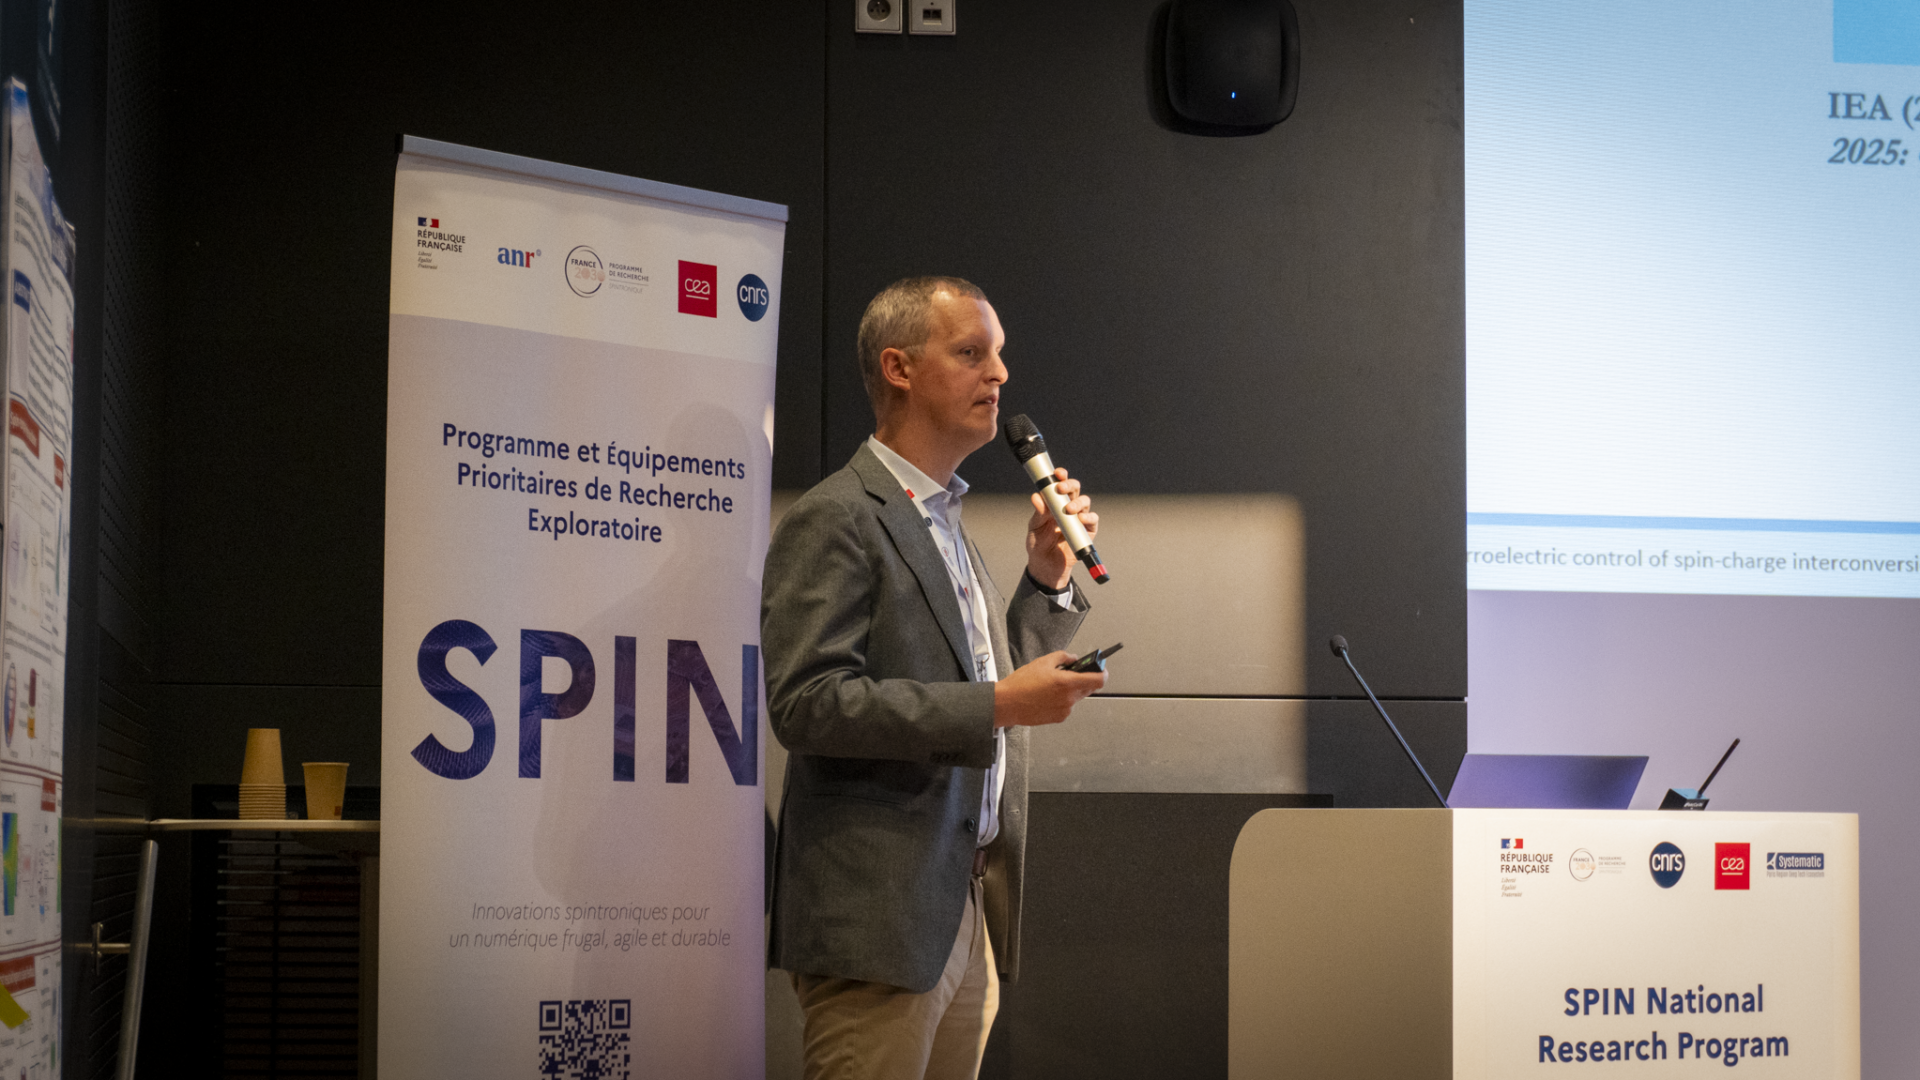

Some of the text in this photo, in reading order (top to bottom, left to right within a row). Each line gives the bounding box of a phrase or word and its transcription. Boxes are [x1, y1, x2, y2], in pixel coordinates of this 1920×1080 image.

[1828, 92, 1892, 120] IEA
[1827, 138, 1909, 166] 2025:
[417, 229, 466, 244] RÉPUBLIQUE
[417, 239, 463, 253] FRANÇAISE
[571, 259, 596, 269] FRANCE
[608, 262, 643, 273] PROGRAMME
[617, 271, 649, 282] RECHERCHE
[684, 278, 711, 295] cea
[739, 285, 767, 306] cnrs
[442, 423, 745, 479] Programme et Équipements
[457, 463, 734, 513] Prioritaires de Recherche
[528, 508, 662, 543] Exploratoire
[1572, 549, 1642, 567] control
[1648, 549, 1669, 567] of
[1674, 550, 1787, 573] spin-charge
[410, 619, 759, 786] SPIN
[1500, 852, 1553, 864] RÉPUBLIQUE
[1651, 853, 1683, 872] cnrs
[1721, 857, 1744, 870] cea
[1778, 855, 1822, 869] Systematic
[1500, 864, 1550, 875] FRANÇAISE
[472, 902, 710, 925] Innovations spintroniques pour
[449, 928, 731, 952] un numérique frugal, agile et durable
[1564, 984, 1763, 1016] SPIN National
[1538, 1031, 1789, 1067] Research Program
